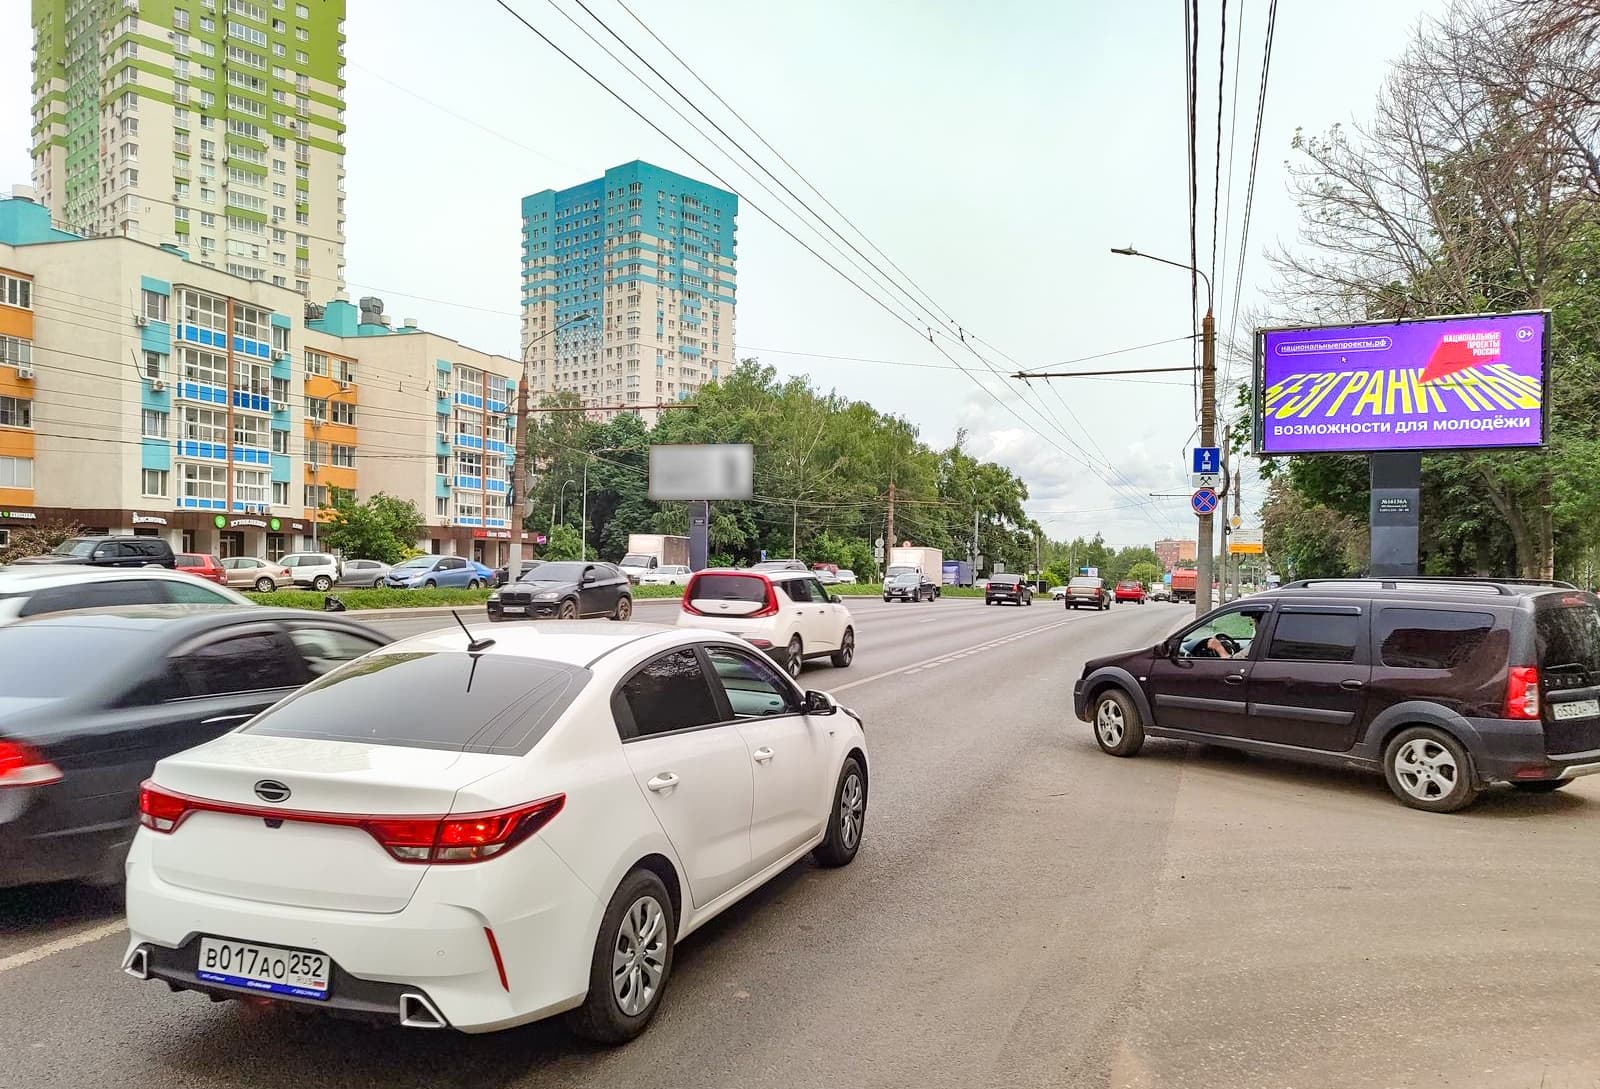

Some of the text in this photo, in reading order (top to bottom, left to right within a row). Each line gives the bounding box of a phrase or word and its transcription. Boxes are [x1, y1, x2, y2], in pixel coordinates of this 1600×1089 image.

[1443, 331, 1501, 343] НАЦИОНАЛЬНЫЕ
[1518, 329, 1533, 339] 0+
[1280, 338, 1388, 353] национальныепроекты.рф
[1467, 340, 1500, 349] ПРОЕКТЫ
[1472, 347, 1500, 356] РОССИИ
[1274, 415, 1531, 436] возможности для молодёжи
[206, 944, 323, 979] В017АО 252
